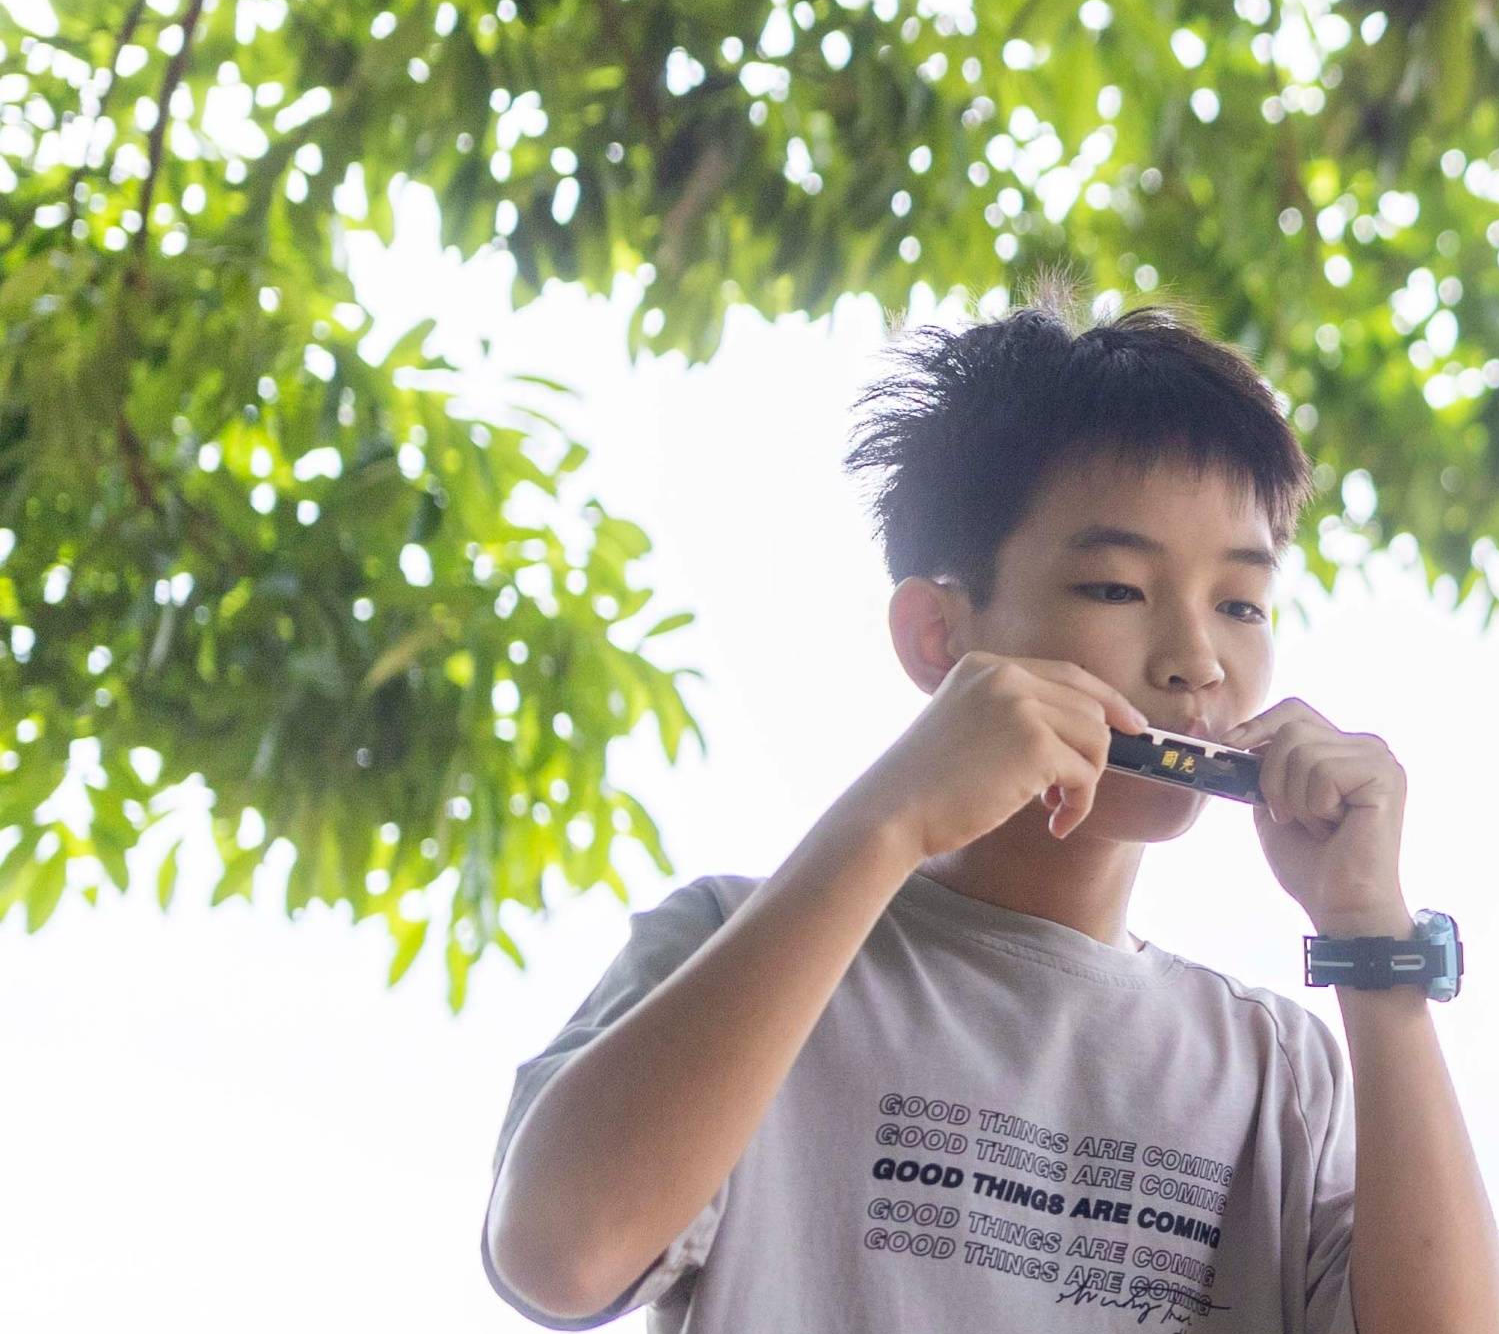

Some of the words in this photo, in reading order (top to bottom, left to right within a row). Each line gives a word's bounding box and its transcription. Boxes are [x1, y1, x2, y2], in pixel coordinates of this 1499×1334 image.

[876, 1124, 967, 1154] GOOD
[976, 1138, 1065, 1181] THINGS
[1073, 1165, 1134, 1190] ARE
[1140, 1175, 1227, 1215] COMING
[880, 1094, 970, 1125] GOOD
[979, 1110, 1068, 1153] THINGS
[1074, 1136, 1136, 1162] ARE
[1143, 1146, 1232, 1187] COMING
[868, 1198, 959, 1228] GOOD
[969, 1212, 1062, 1253] THINGS
[1066, 1236, 1127, 1263] ARE
[873, 1158, 964, 1188] GOOD
[973, 1173, 1064, 1215] THINGS
[1070, 1198, 1132, 1223] ARE
[1137, 1208, 1221, 1249] COMING
[864, 1228, 955, 1259] GOOD
[964, 1241, 1058, 1282] THINGS
[1065, 1266, 1124, 1293] ARE
